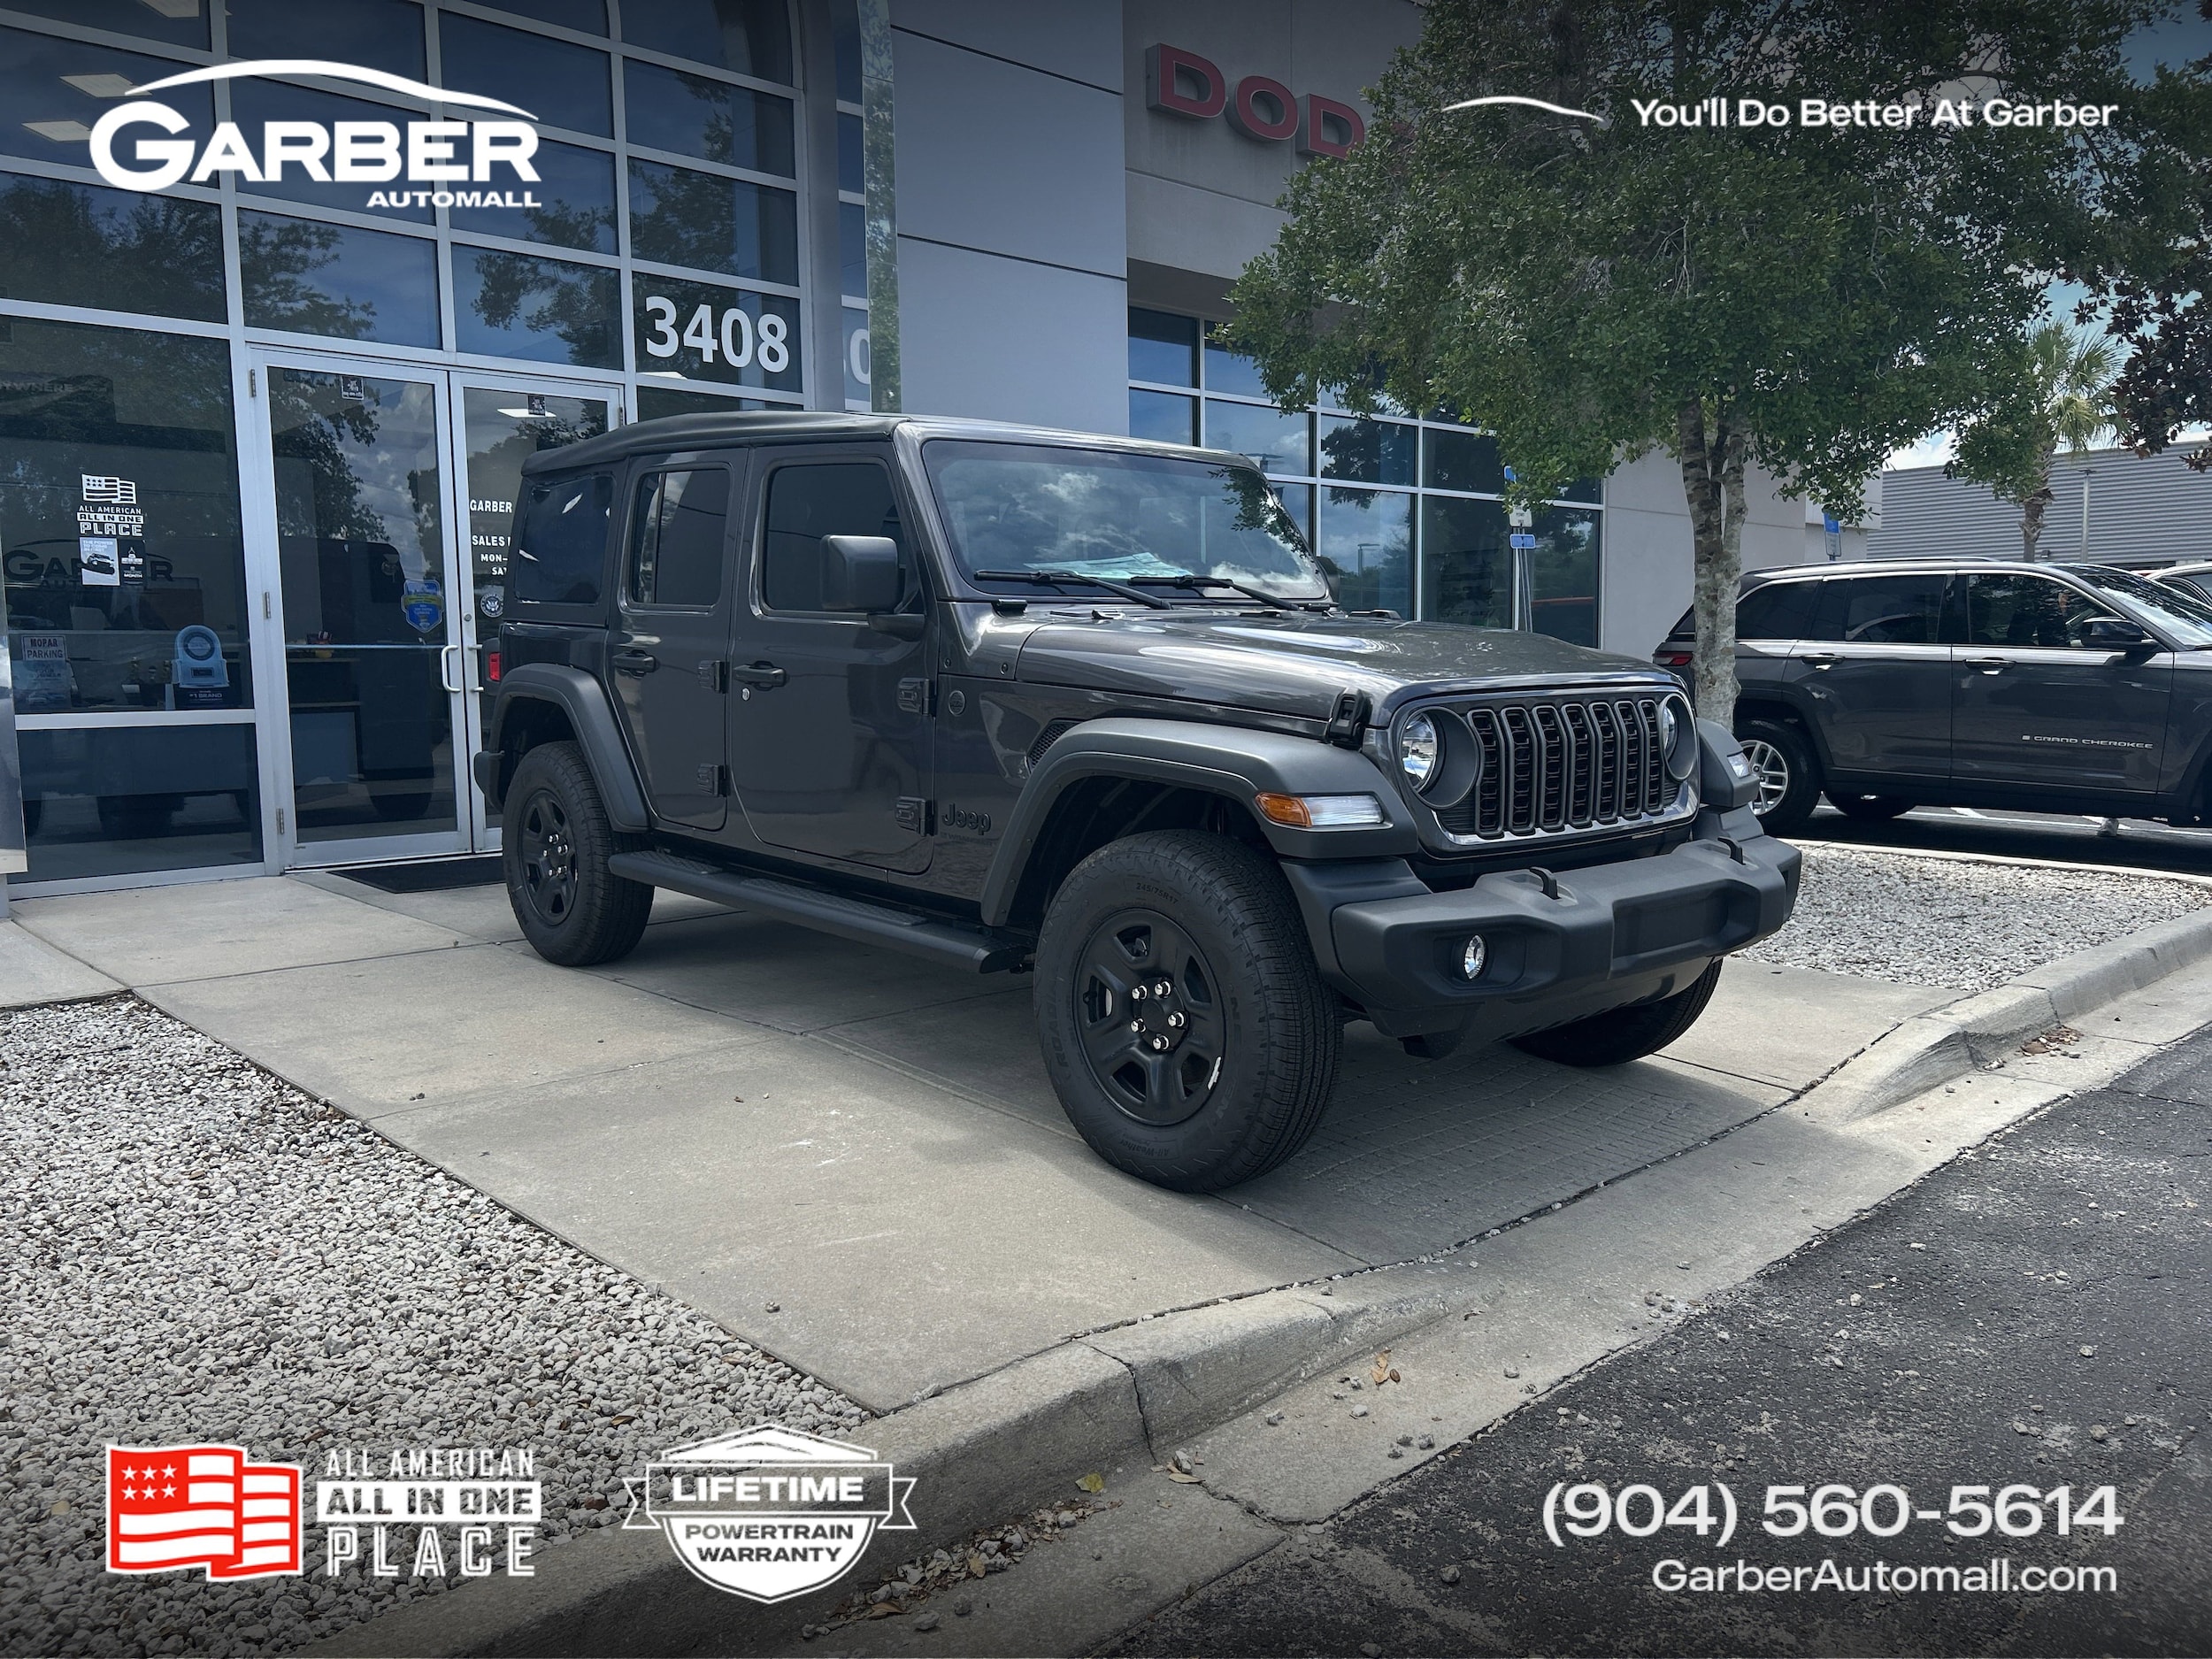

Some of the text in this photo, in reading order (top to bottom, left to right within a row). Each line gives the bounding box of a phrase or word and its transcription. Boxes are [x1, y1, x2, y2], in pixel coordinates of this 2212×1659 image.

[1147, 42, 1367, 161] DOD
[646, 296, 789, 373] 3408
[97, 506, 142, 515] AMERICAN
[470, 499, 512, 513] GARBER
[80, 522, 142, 537] PLACE
[472, 534, 505, 547] SALES
[30, 638, 58, 648] MOPAR
[27, 649, 64, 658] PARKING
[2081, 739, 2154, 749] CHEROKEE
[941, 803, 991, 835] Jeep
